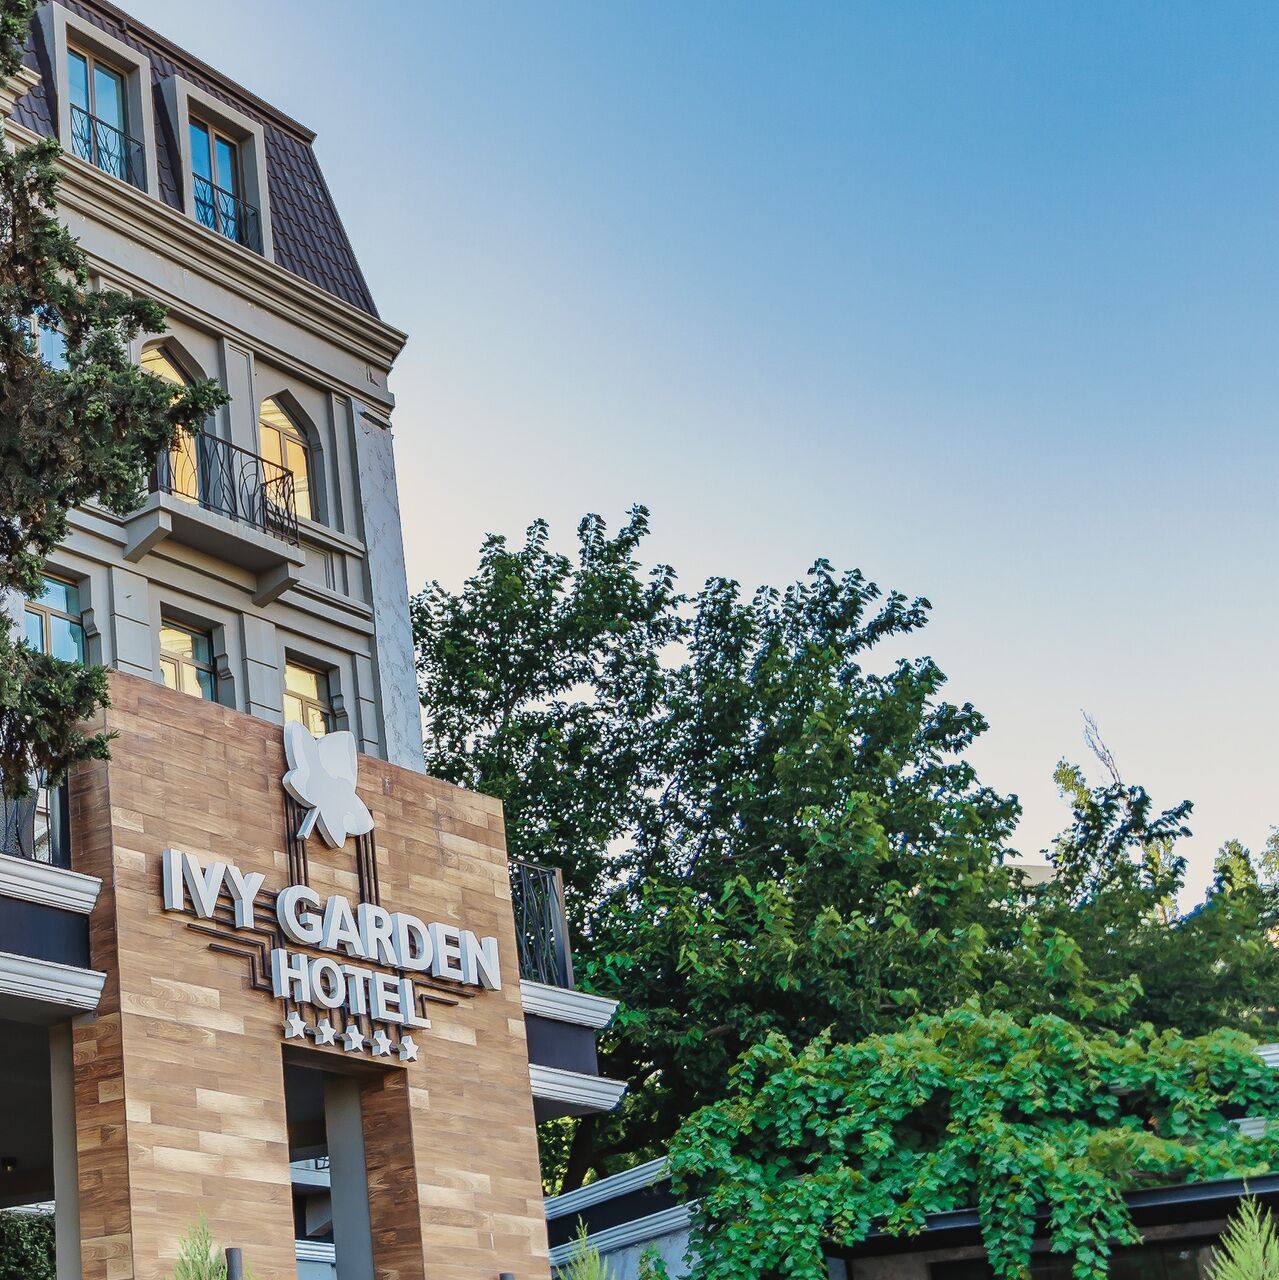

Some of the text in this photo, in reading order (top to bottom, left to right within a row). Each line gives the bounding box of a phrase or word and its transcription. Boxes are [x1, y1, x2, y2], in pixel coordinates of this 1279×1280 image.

[163, 848, 502, 991] IVY GARDEN
[271, 948, 432, 1029] HOTEL
